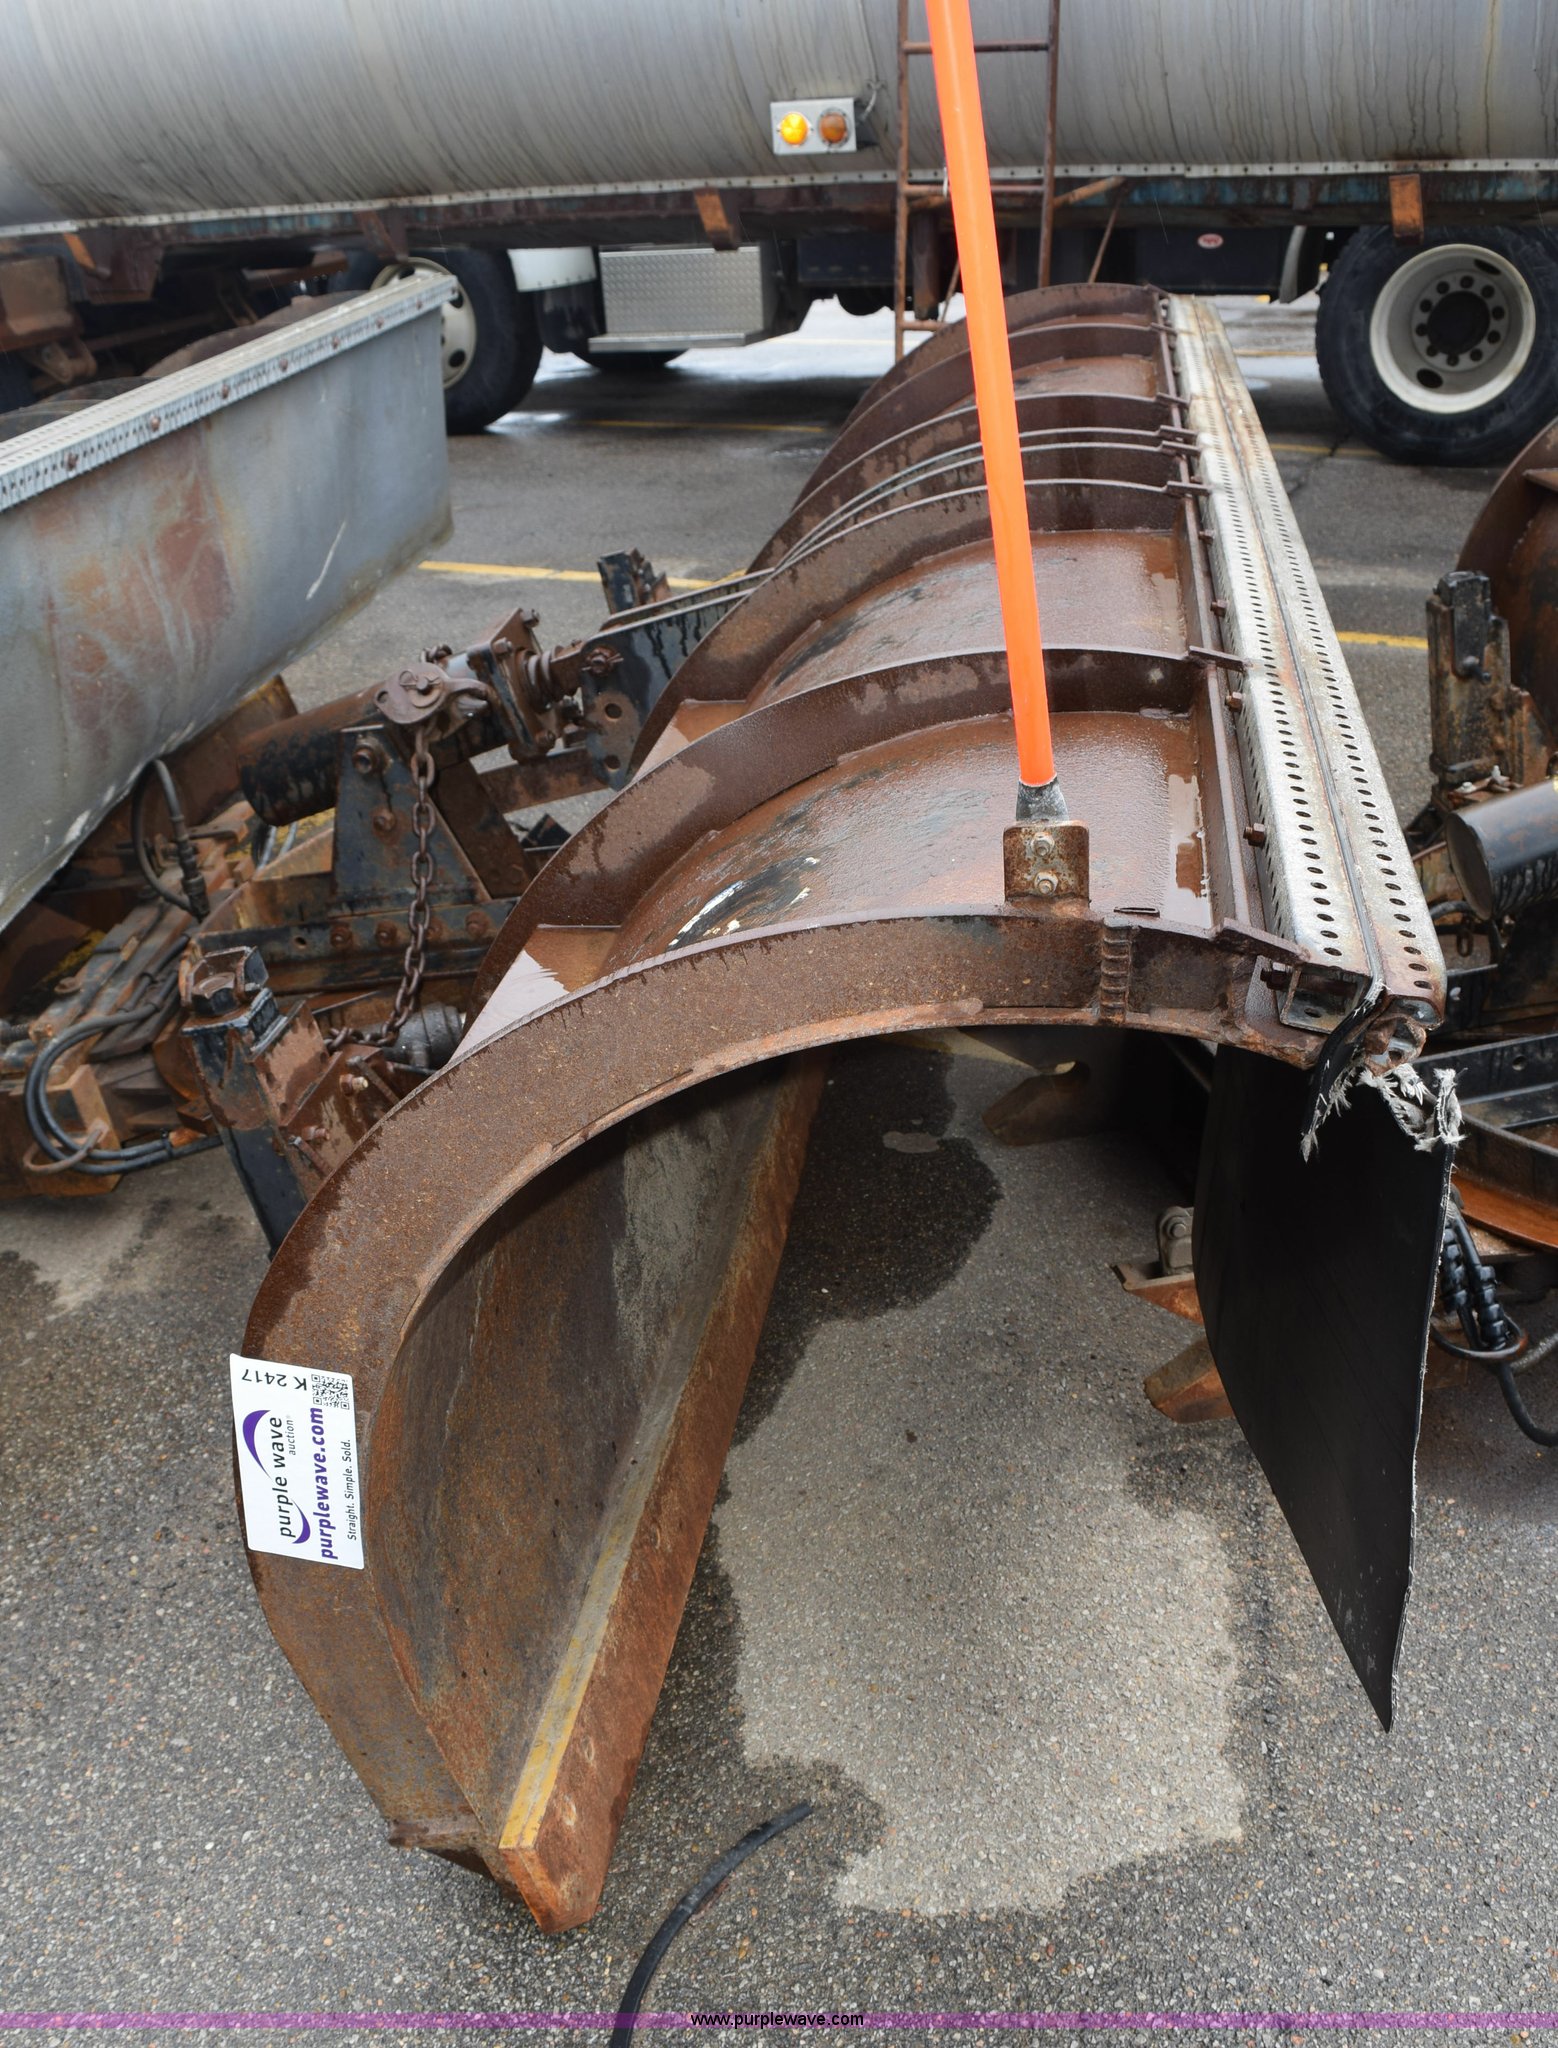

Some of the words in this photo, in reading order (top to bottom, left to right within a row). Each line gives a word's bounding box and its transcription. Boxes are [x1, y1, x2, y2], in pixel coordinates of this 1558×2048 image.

[241, 1369, 288, 1388] 2417
[294, 1376, 308, 1391] K
[269, 1416, 287, 1469] wave
[285, 1419, 296, 1456] auction
[340, 1439, 352, 1463] Sold.
[310, 1407, 339, 1560] purplewave.com
[342, 1465, 356, 1500] Simple.
[272, 1476, 297, 1538] purple
[345, 1502, 358, 1541] Straight.
